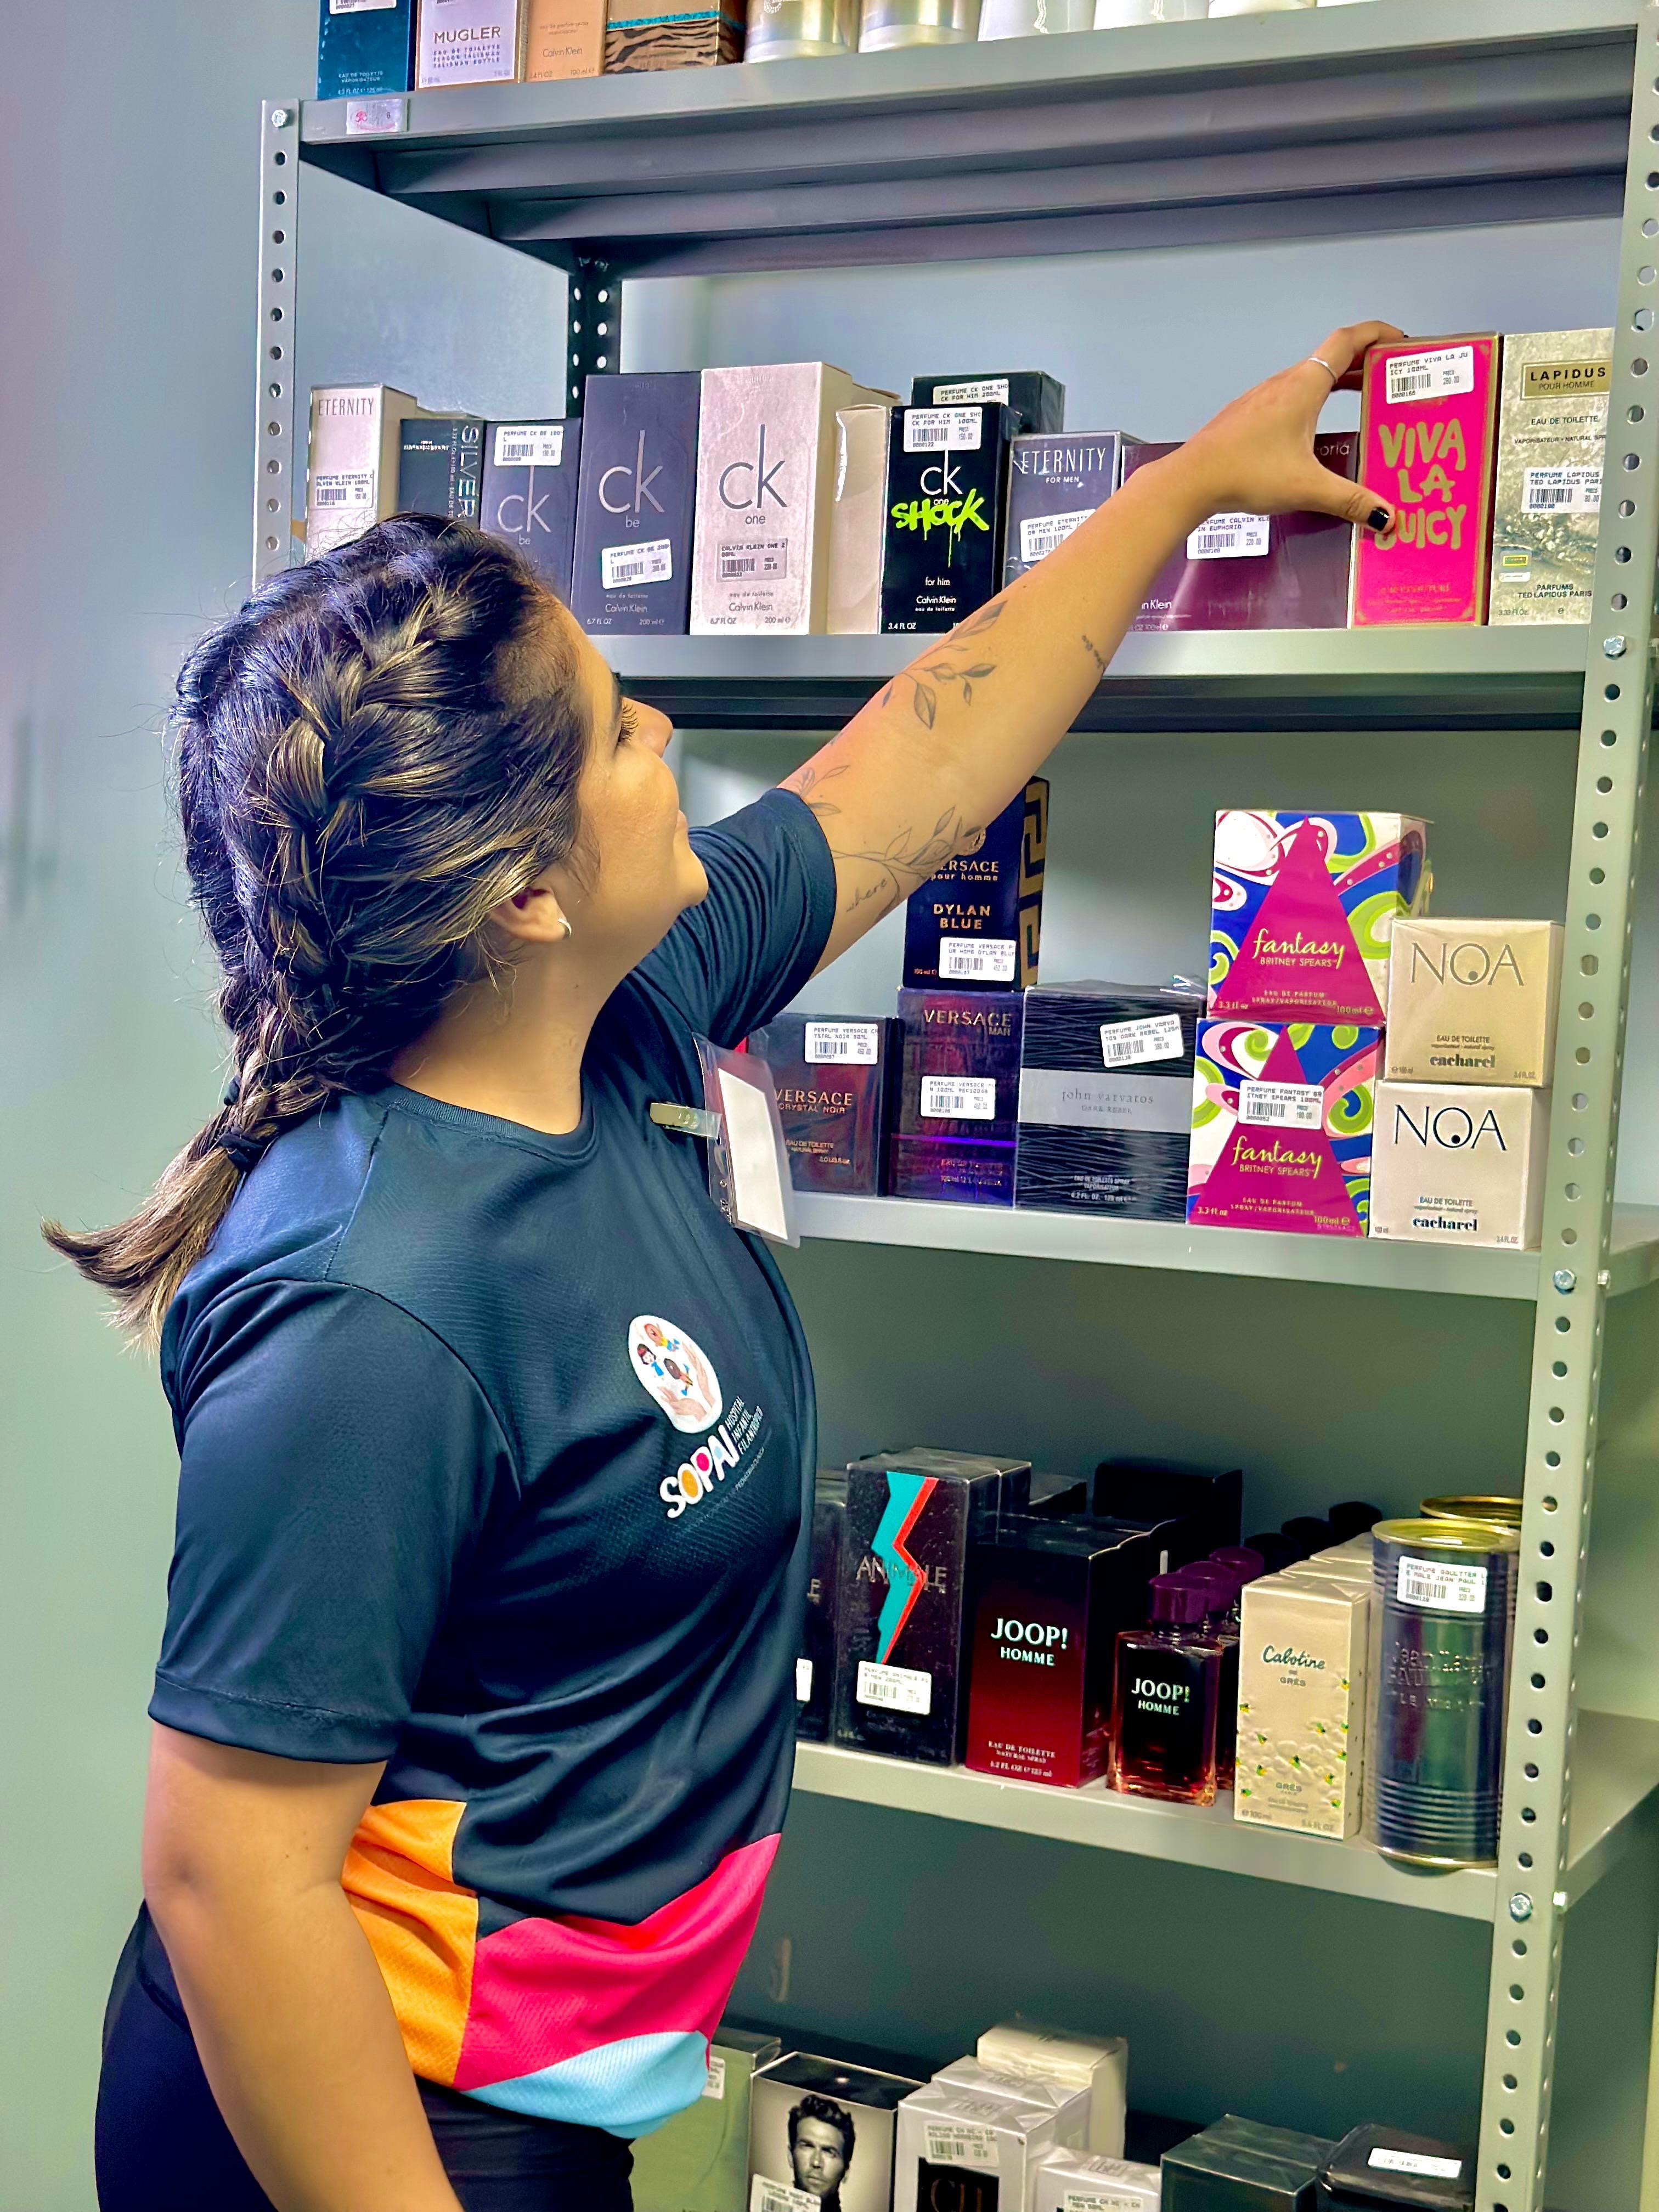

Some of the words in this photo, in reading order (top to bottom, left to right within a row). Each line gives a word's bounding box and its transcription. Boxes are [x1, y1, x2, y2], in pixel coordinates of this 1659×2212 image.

[435, 26, 500, 44] MUGLER
[543, 48, 563, 57] Calvin
[565, 46, 582, 55] Klein
[1390, 360, 1419, 369] PERFUME
[1531, 366, 1606, 381] LAPIDUS
[1538, 382, 1561, 391] POUR
[1563, 380, 1594, 388] HOMME
[318, 398, 374, 416] ETERNITY
[1378, 419, 1466, 471] VIVA
[719, 424, 788, 510] ck
[1023, 448, 1105, 474] ETERNITY
[458, 425, 479, 517] SILVER
[599, 430, 665, 514] ck
[921, 450, 963, 495] ck
[1397, 465, 1455, 503] LA
[497, 465, 551, 533] ck
[891, 488, 990, 534] SHOCK
[625, 516, 640, 528] be
[745, 514, 766, 525] one
[1028, 521, 1053, 529] PERFUME
[519, 534, 531, 546] be
[925, 577, 935, 586] for
[937, 577, 950, 585] him
[729, 602, 753, 611] Calvin
[754, 601, 772, 611] Klein
[916, 595, 938, 603] Calvin
[939, 595, 956, 603] Klein
[1150, 599, 1172, 610] Klein
[605, 603, 629, 613] Calvin
[629, 604, 647, 613] Klein
[961, 872, 998, 881] homme
[933, 904, 991, 916] DYLAN
[940, 918, 983, 929] BLUE
[1252, 928, 1344, 969] fantasy
[1260, 957, 1295, 967] BRITNEY
[1300, 958, 1332, 967] SPEARS
[1411, 943, 1525, 987] NOA
[924, 1009, 1012, 1027] VERSACE
[989, 1026, 1011, 1036] MAN
[1104, 1026, 1131, 1035] PERFUME
[1430, 1053, 1496, 1069] cacharel
[775, 1088, 853, 1107] VERSACE
[1062, 1088, 1091, 1102] john
[1098, 1093, 1154, 1104] varvatos
[779, 1103, 819, 1113] CRYSTAL
[823, 1106, 846, 1114] NOIR
[1082, 1104, 1104, 1113] DARK
[1107, 1105, 1132, 1114] REBEL
[1395, 1104, 1508, 1152] NOA
[1232, 1136, 1322, 1179] fantasy
[1239, 1164, 1273, 1173] BRITNEY
[1278, 1166, 1310, 1177] SPEARS
[1444, 1198, 1473, 1207] TOILETTE
[1314, 1215, 1328, 1223] 100
[1412, 1216, 1478, 1232] cacharel
[725, 1395, 745, 1431] HOSPITAL
[731, 1409, 753, 1443] INFANTIL
[1407, 1563, 1436, 1573] PERFUME
[990, 1617, 1068, 1650] JOOP!
[1001, 1646, 1055, 1666] HOMME
[1262, 1645, 1326, 1671] Cabotine
[1131, 1678, 1190, 1703] JOOP!
[1138, 1700, 1180, 1716] HOMME
[989, 1740, 1003, 1748] EAU
[1018, 1746, 1056, 1758] TOILETTE
